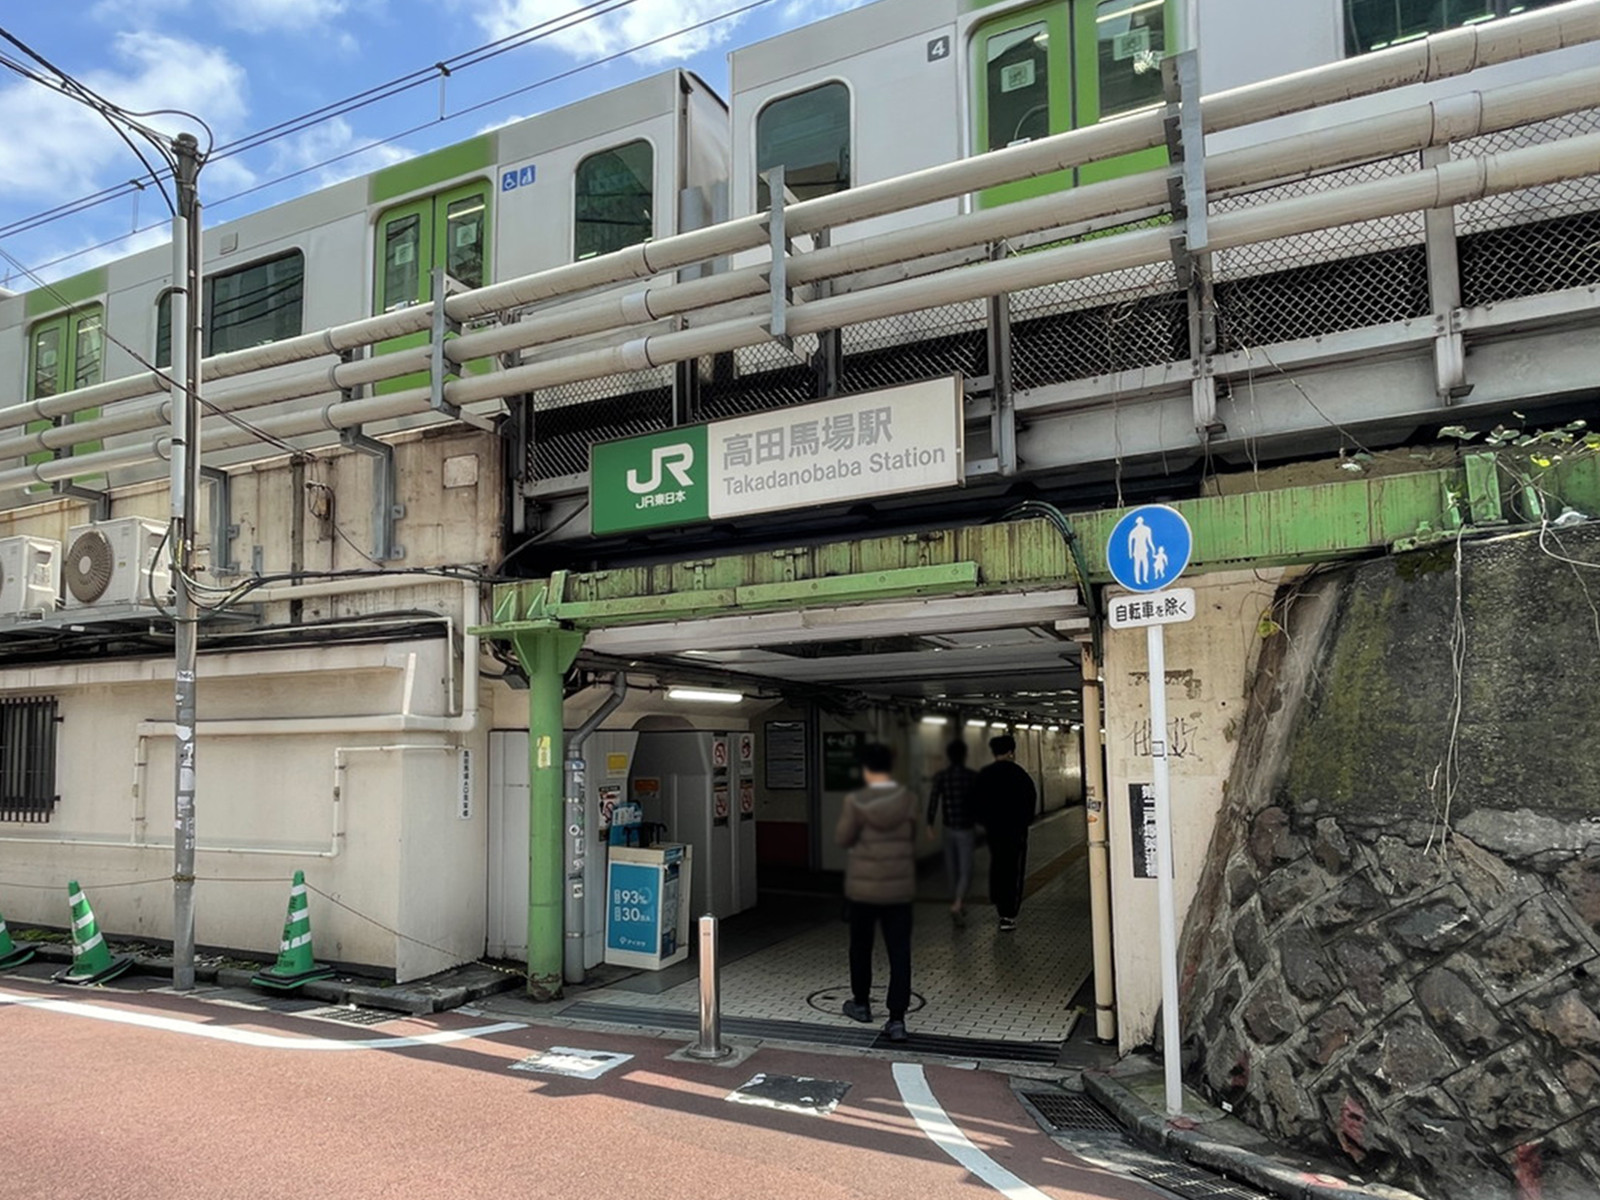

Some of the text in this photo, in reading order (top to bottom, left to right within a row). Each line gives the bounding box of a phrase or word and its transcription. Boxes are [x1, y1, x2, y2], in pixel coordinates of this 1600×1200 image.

[931, 40, 946, 56] 4
[722, 406, 893, 471] 高田馬場駅
[627, 443, 694, 494] JR
[723, 446, 946, 496] Takadanobaba Station
[635, 490, 687, 509] JR東日本
[1116, 597, 1188, 622] 自転車を除く
